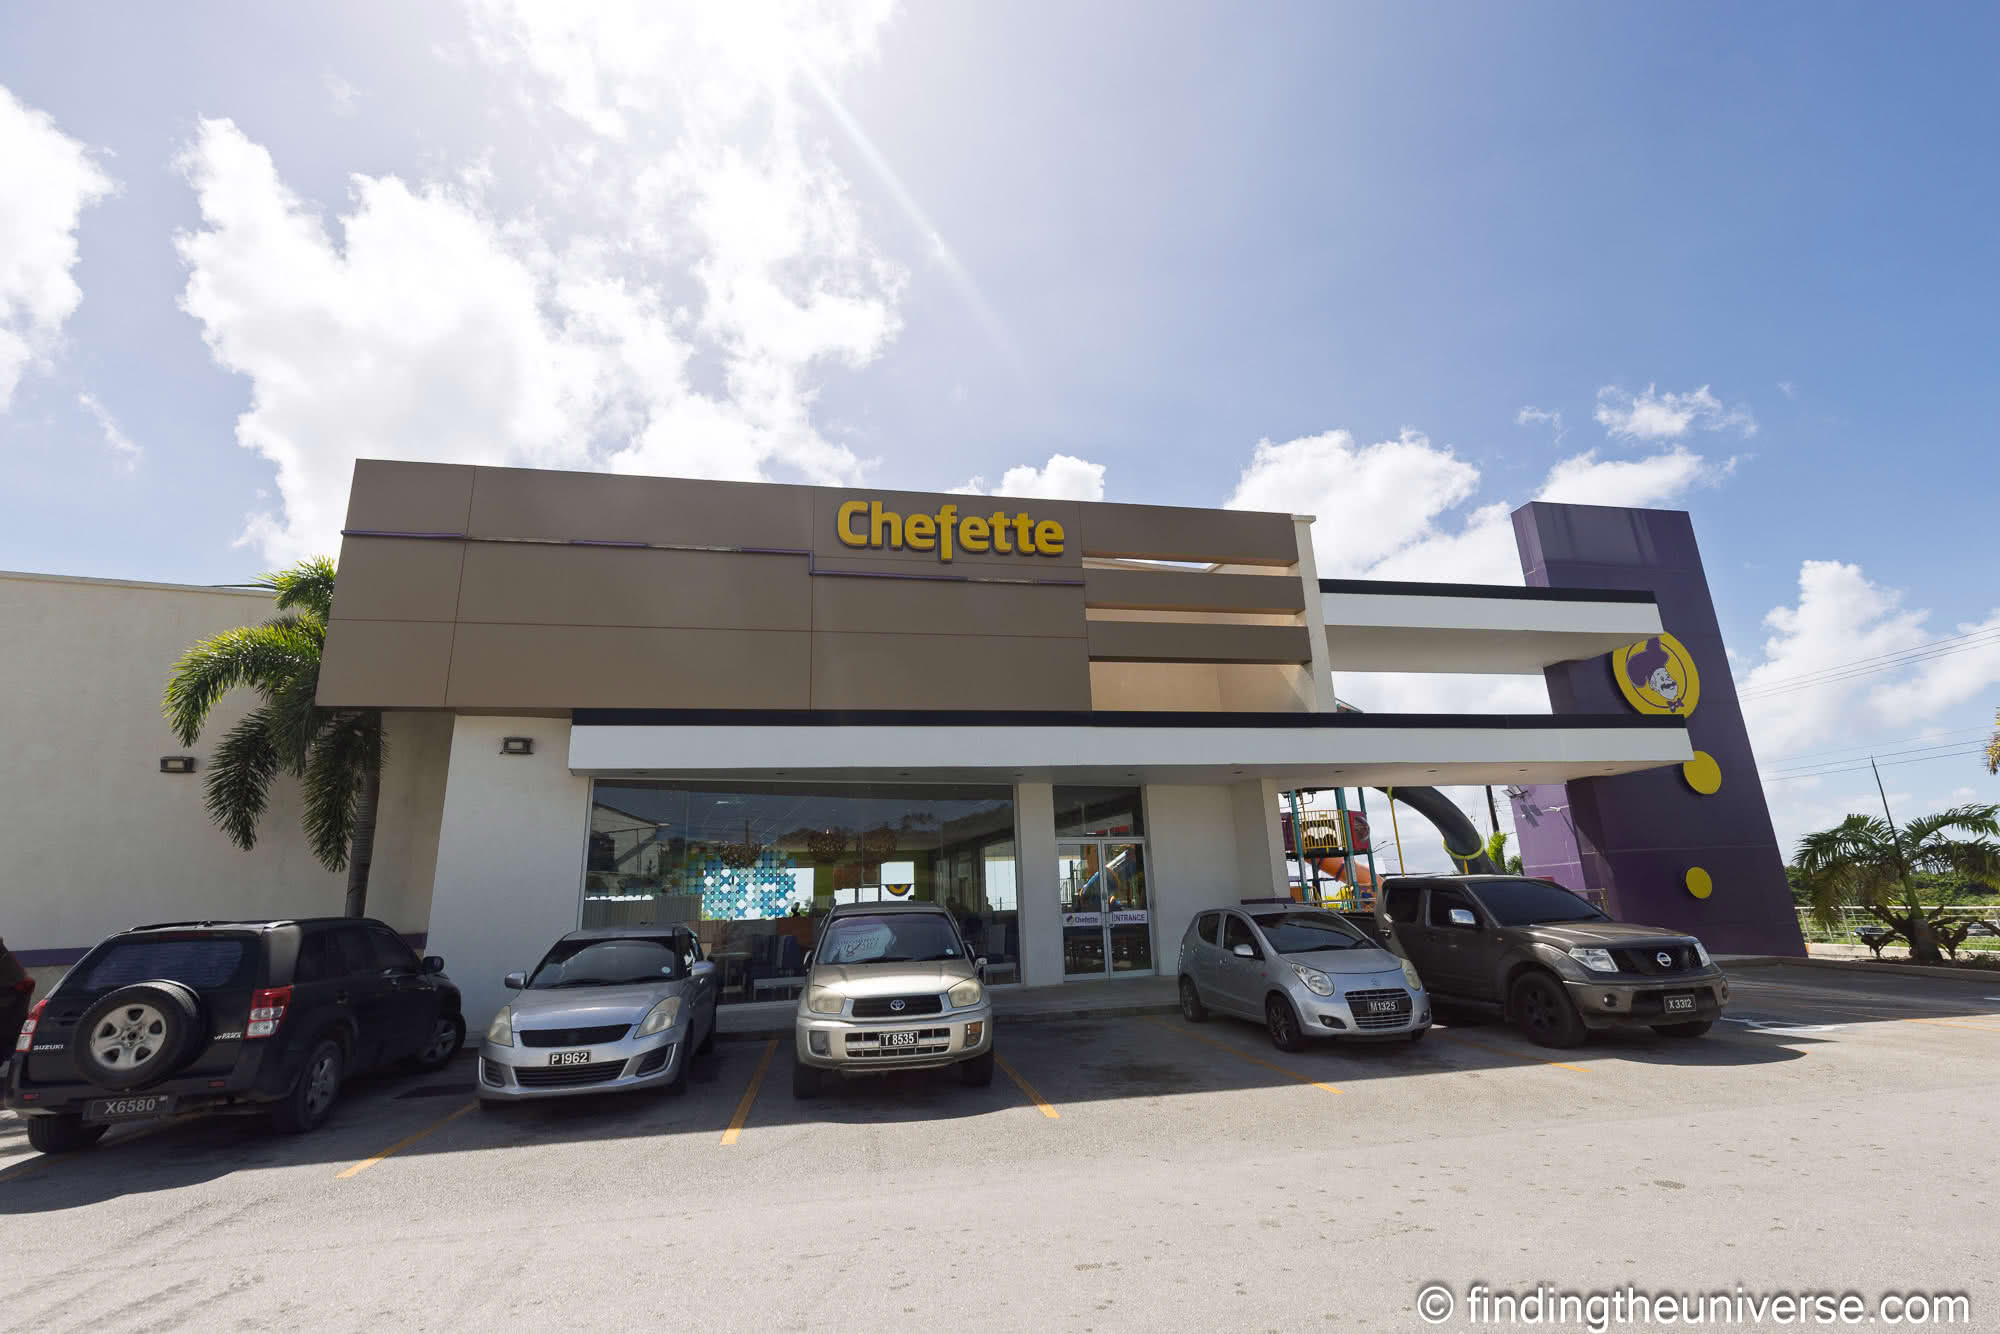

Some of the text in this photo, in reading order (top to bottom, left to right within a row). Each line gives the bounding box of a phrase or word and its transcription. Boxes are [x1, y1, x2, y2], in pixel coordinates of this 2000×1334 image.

[837, 500, 1065, 563] Chefette
[551, 1052, 588, 1065] P1962
[104, 1099, 156, 1114] X6580
